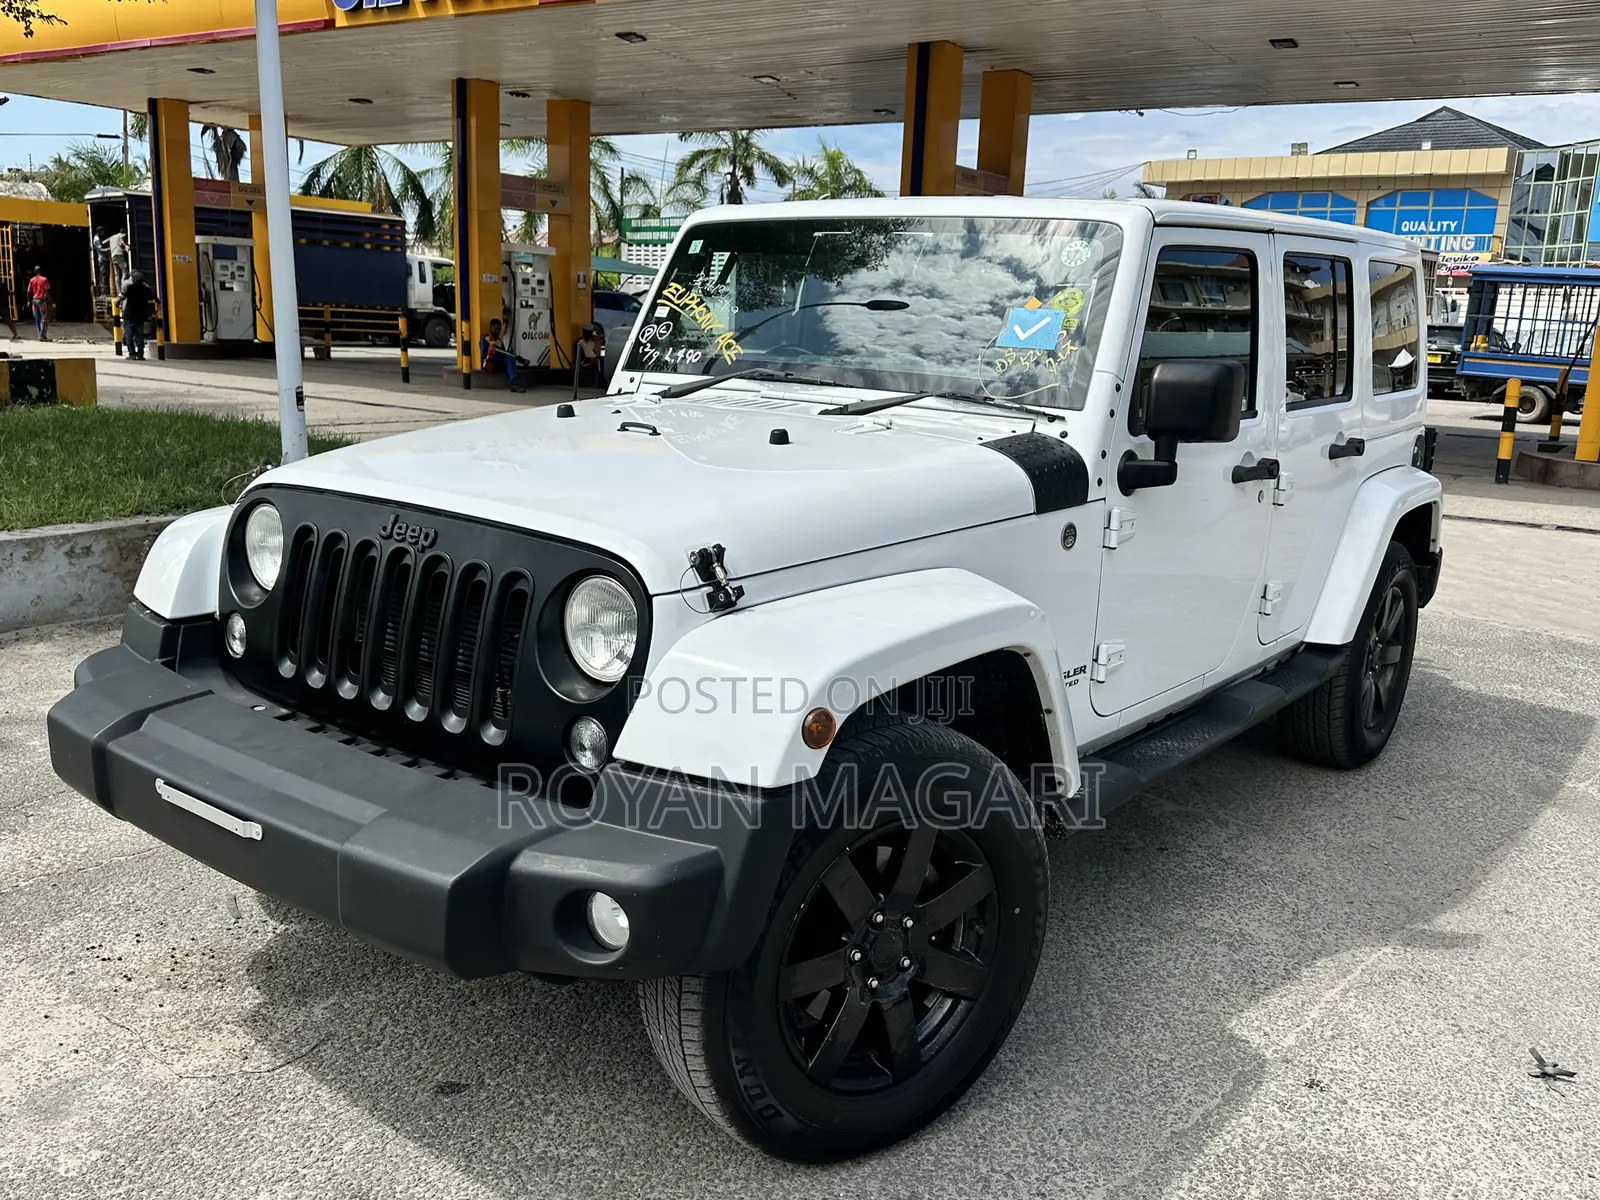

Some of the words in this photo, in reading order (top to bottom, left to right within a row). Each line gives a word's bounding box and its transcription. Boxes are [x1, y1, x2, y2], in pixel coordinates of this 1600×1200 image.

[1401, 220, 1458, 232] QUALITY
[522, 332, 549, 340] OILCOM
[662, 282, 724, 333] EUPHONY
[715, 331, 744, 365] ACE
[379, 512, 438, 553] Jeep
